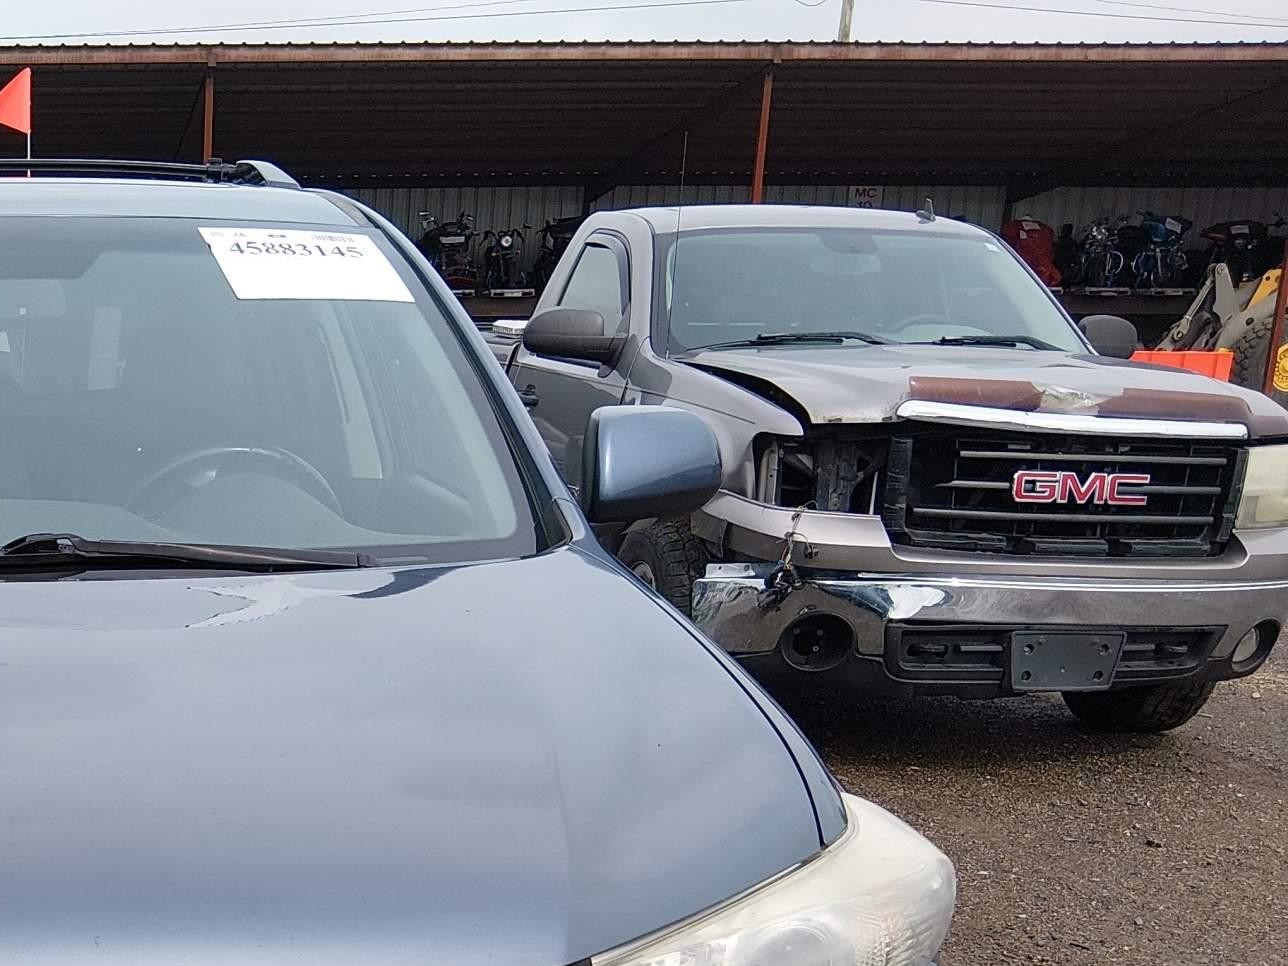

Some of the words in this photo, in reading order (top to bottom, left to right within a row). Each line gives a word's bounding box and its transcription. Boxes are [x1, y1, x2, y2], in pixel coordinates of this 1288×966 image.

[855, 188, 877, 198] MC
[230, 241, 363, 258] 45883145
[1013, 471, 1150, 505] GMC
